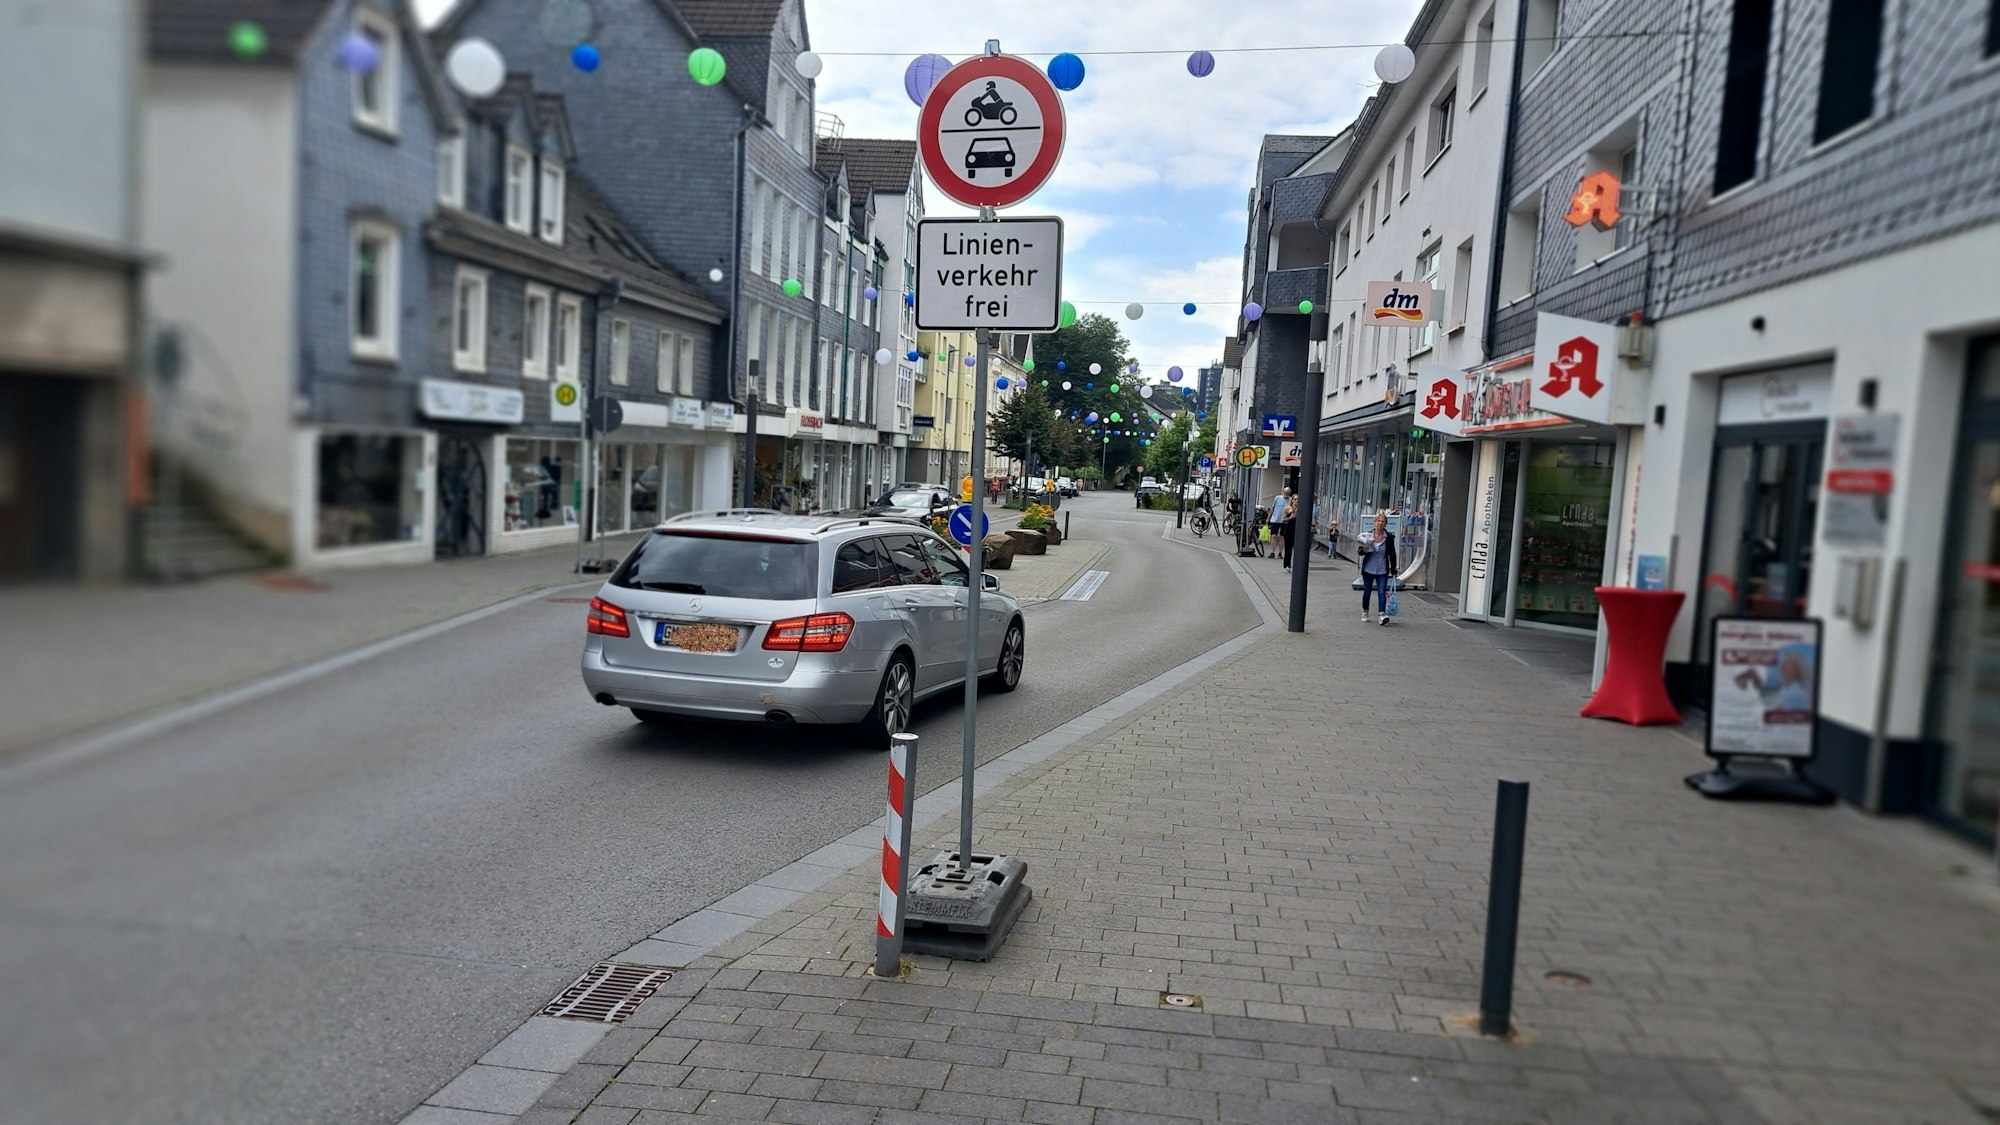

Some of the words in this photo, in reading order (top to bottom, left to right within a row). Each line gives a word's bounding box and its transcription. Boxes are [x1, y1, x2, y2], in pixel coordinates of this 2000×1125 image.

[943, 232, 1033, 255] Linien-
[937, 263, 1038, 286] verkehr
[965, 295, 1008, 318] frei
[1383, 288, 1419, 309] dm
[1242, 451, 1252, 463] H
[1482, 476, 1495, 535] Apotheken
